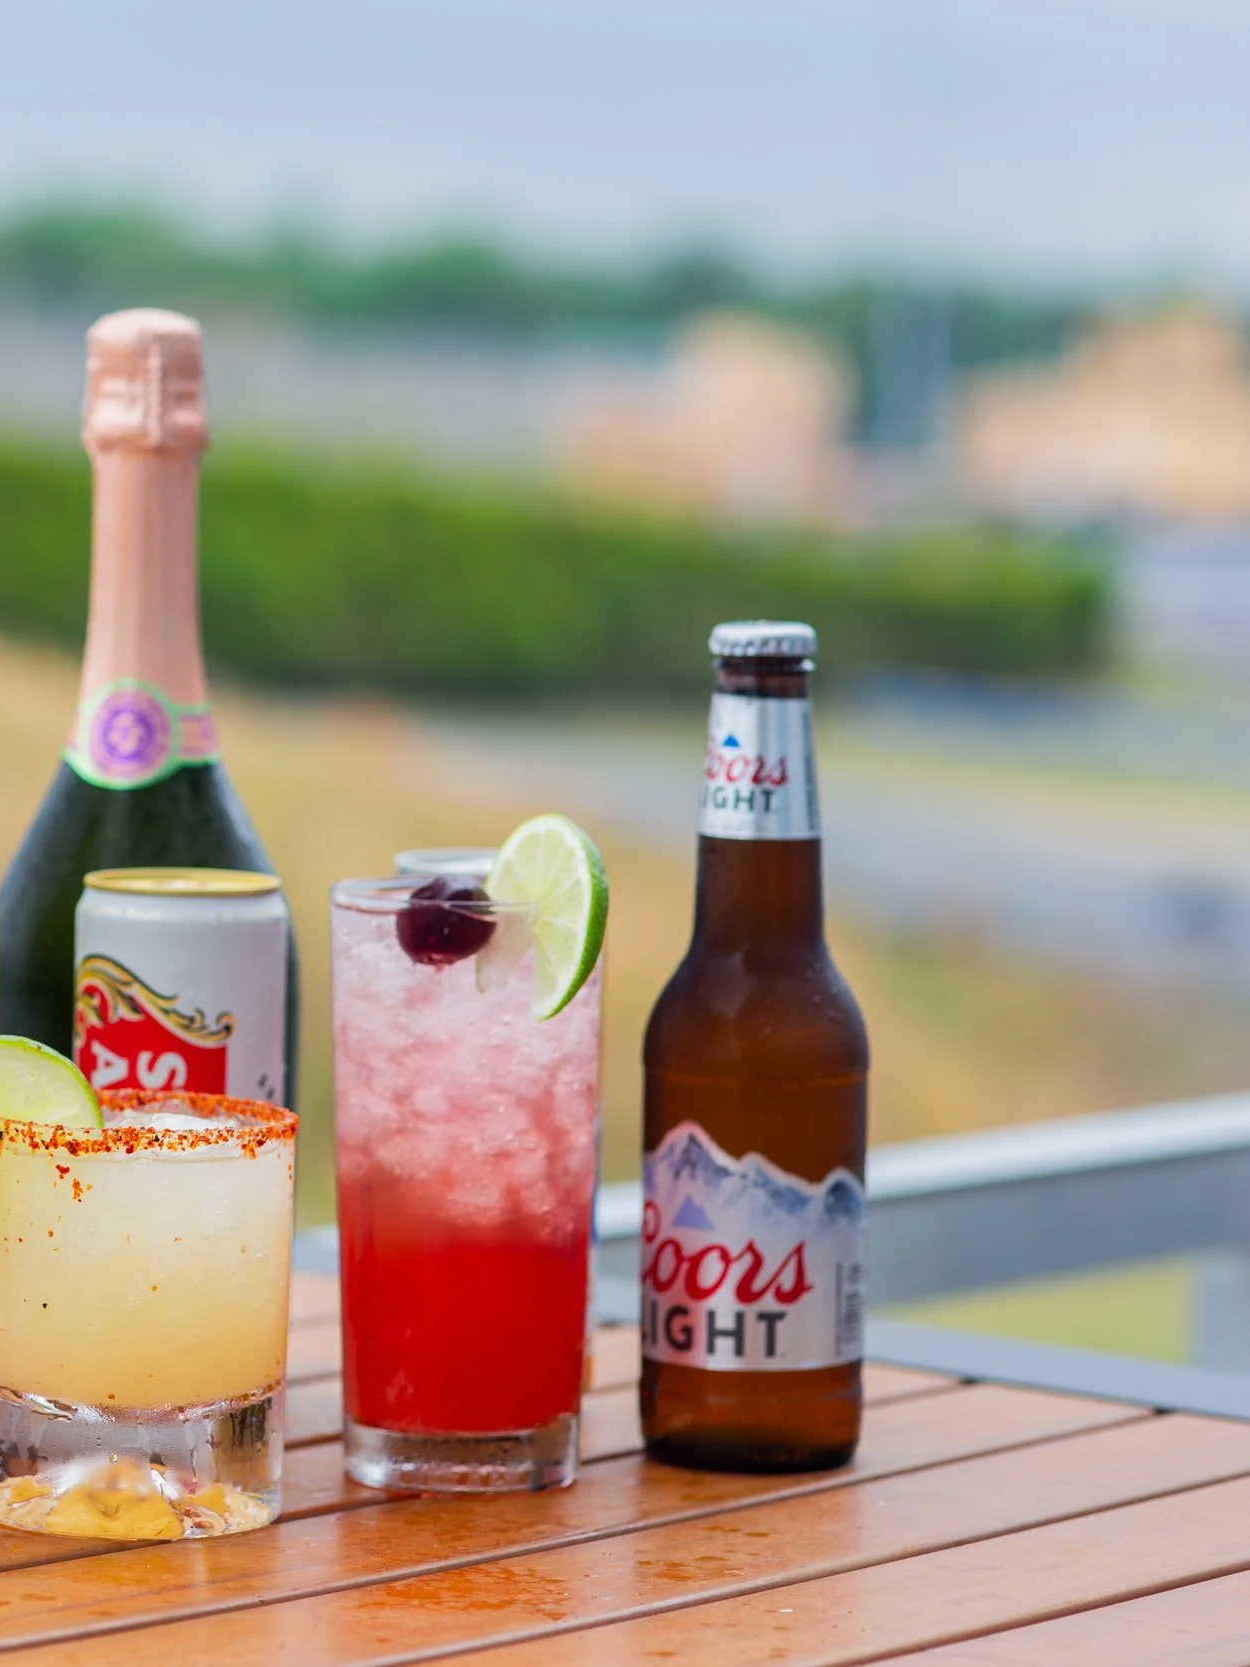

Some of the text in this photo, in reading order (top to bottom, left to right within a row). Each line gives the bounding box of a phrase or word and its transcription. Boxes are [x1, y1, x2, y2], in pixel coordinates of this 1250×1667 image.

[703, 750, 789, 786] oors
[702, 785, 776, 813] IGHT
[642, 1301, 789, 1359] IGHT
